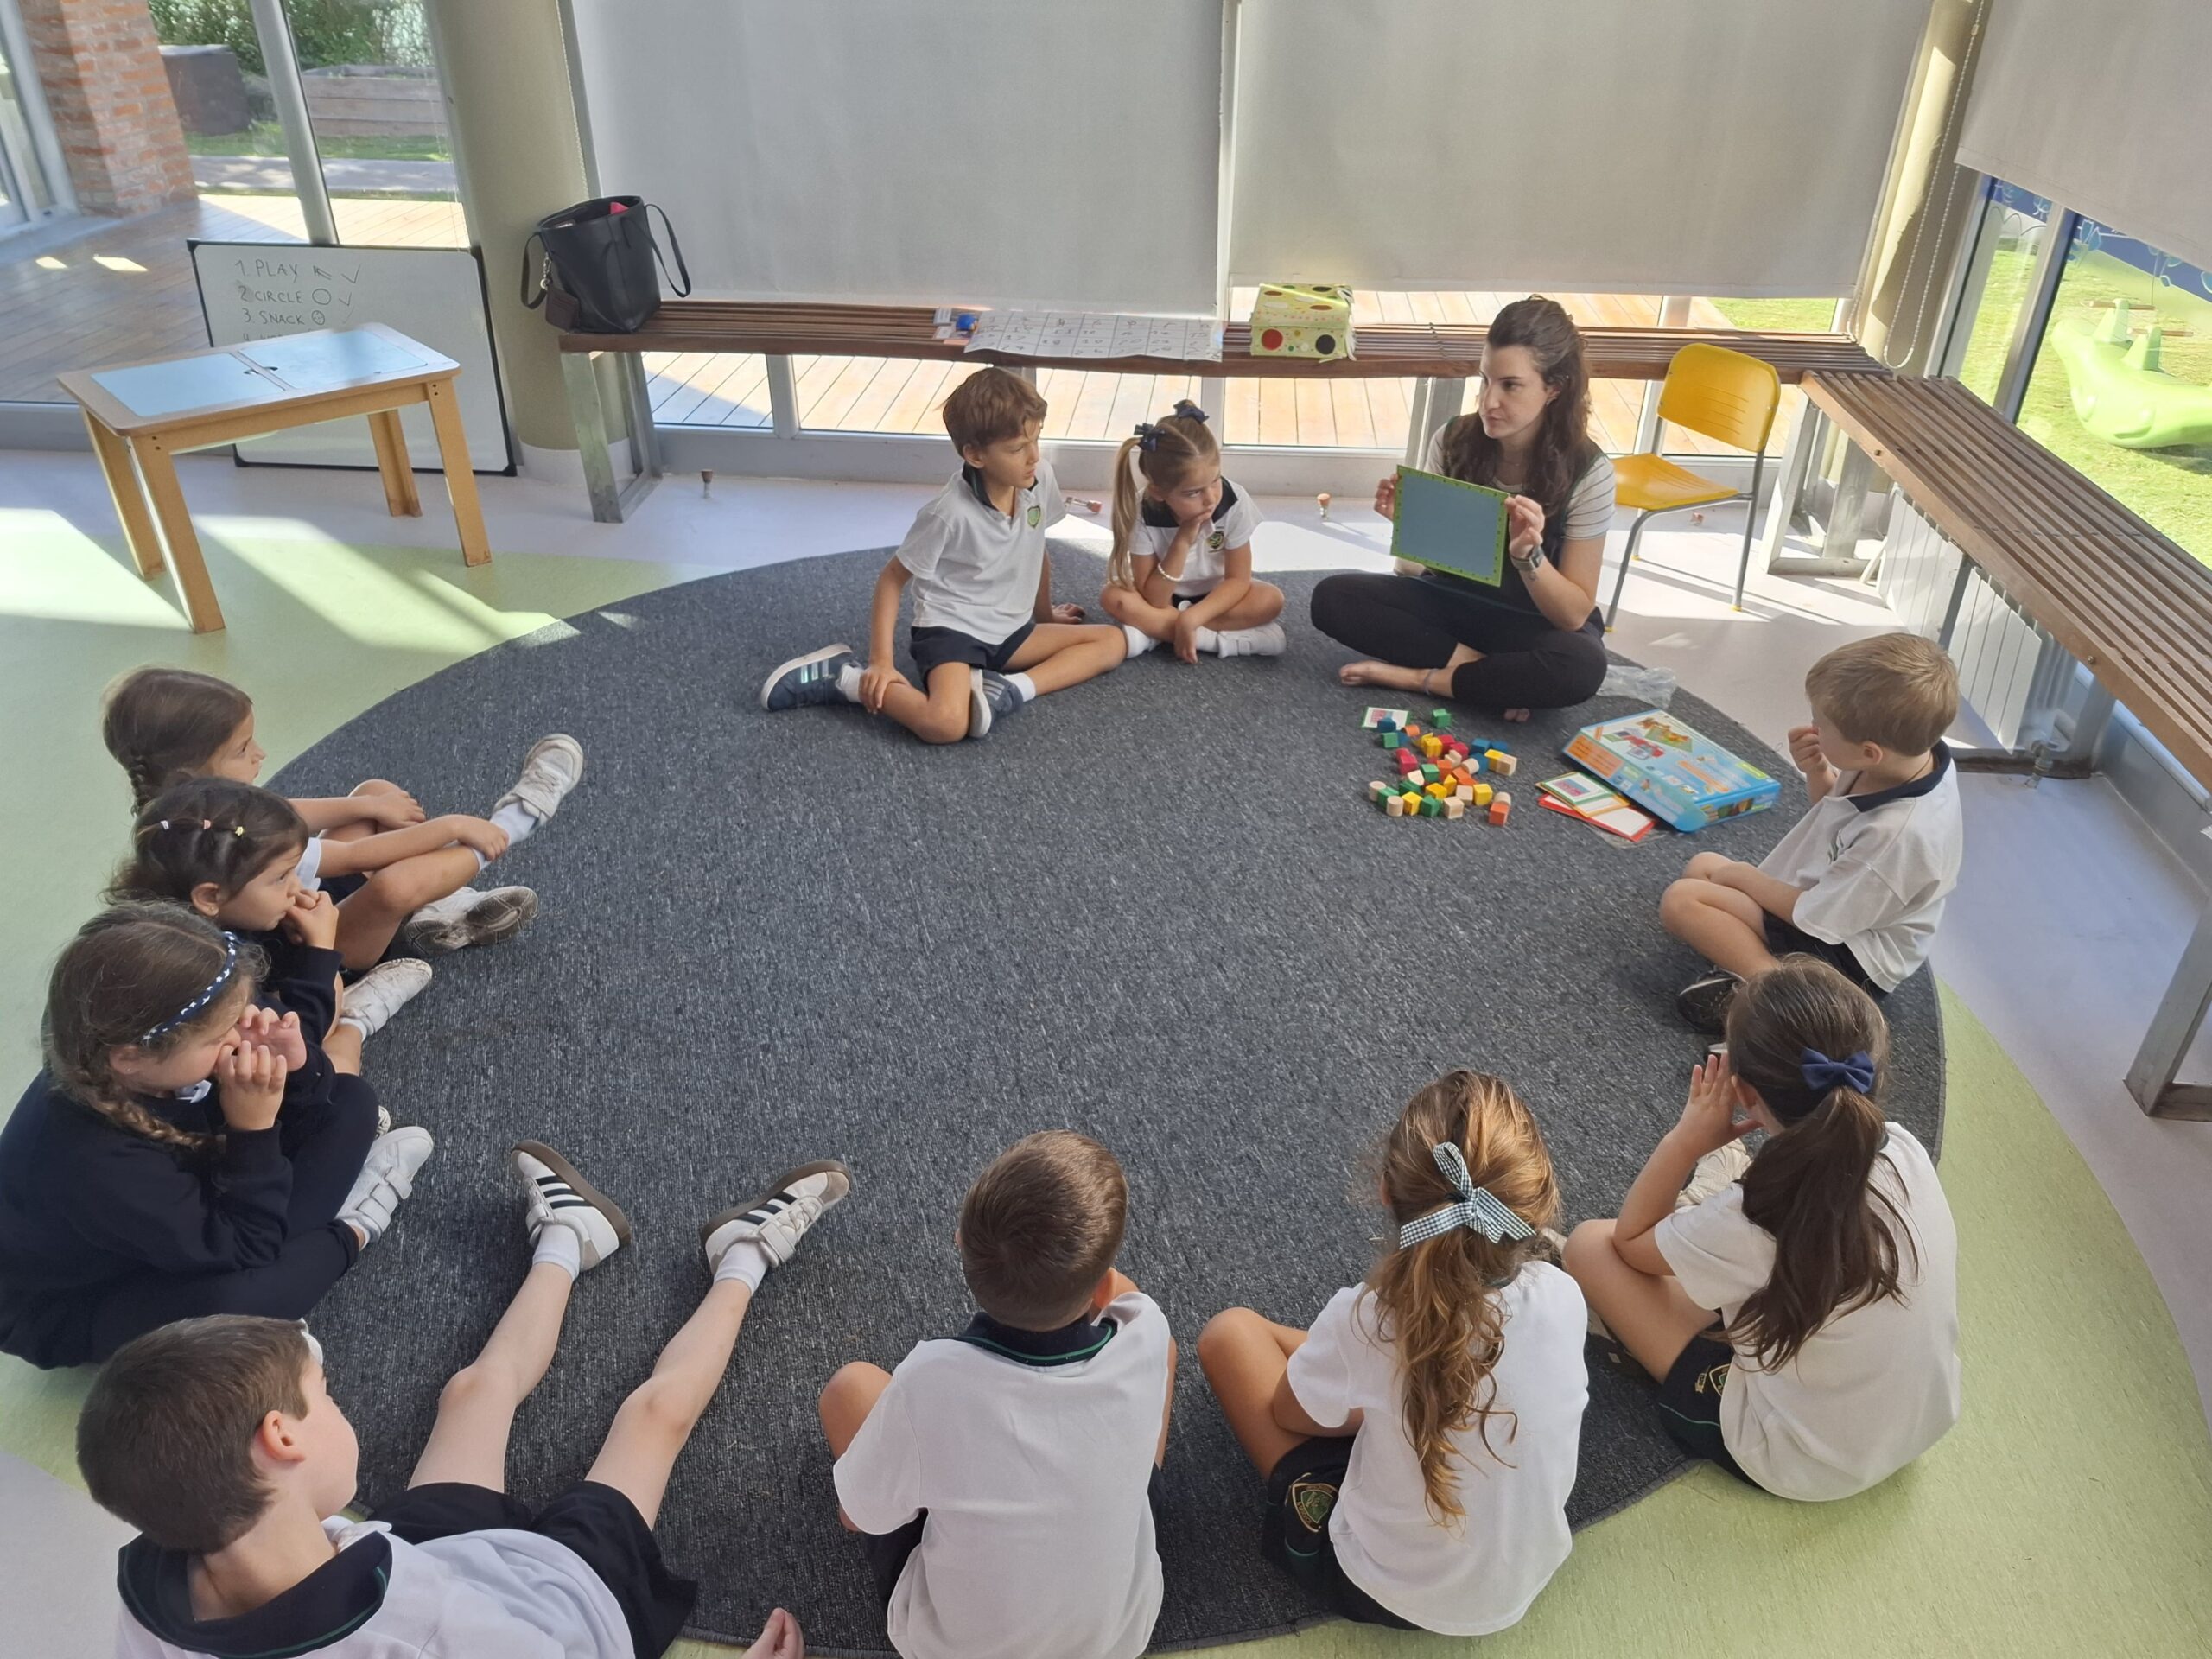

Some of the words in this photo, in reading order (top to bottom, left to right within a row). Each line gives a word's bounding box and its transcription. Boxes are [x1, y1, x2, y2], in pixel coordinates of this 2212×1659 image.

[255, 258, 298, 283] PLAY
[254, 289, 303, 303] CIRCLE
[258, 309, 305, 325] SNACK
